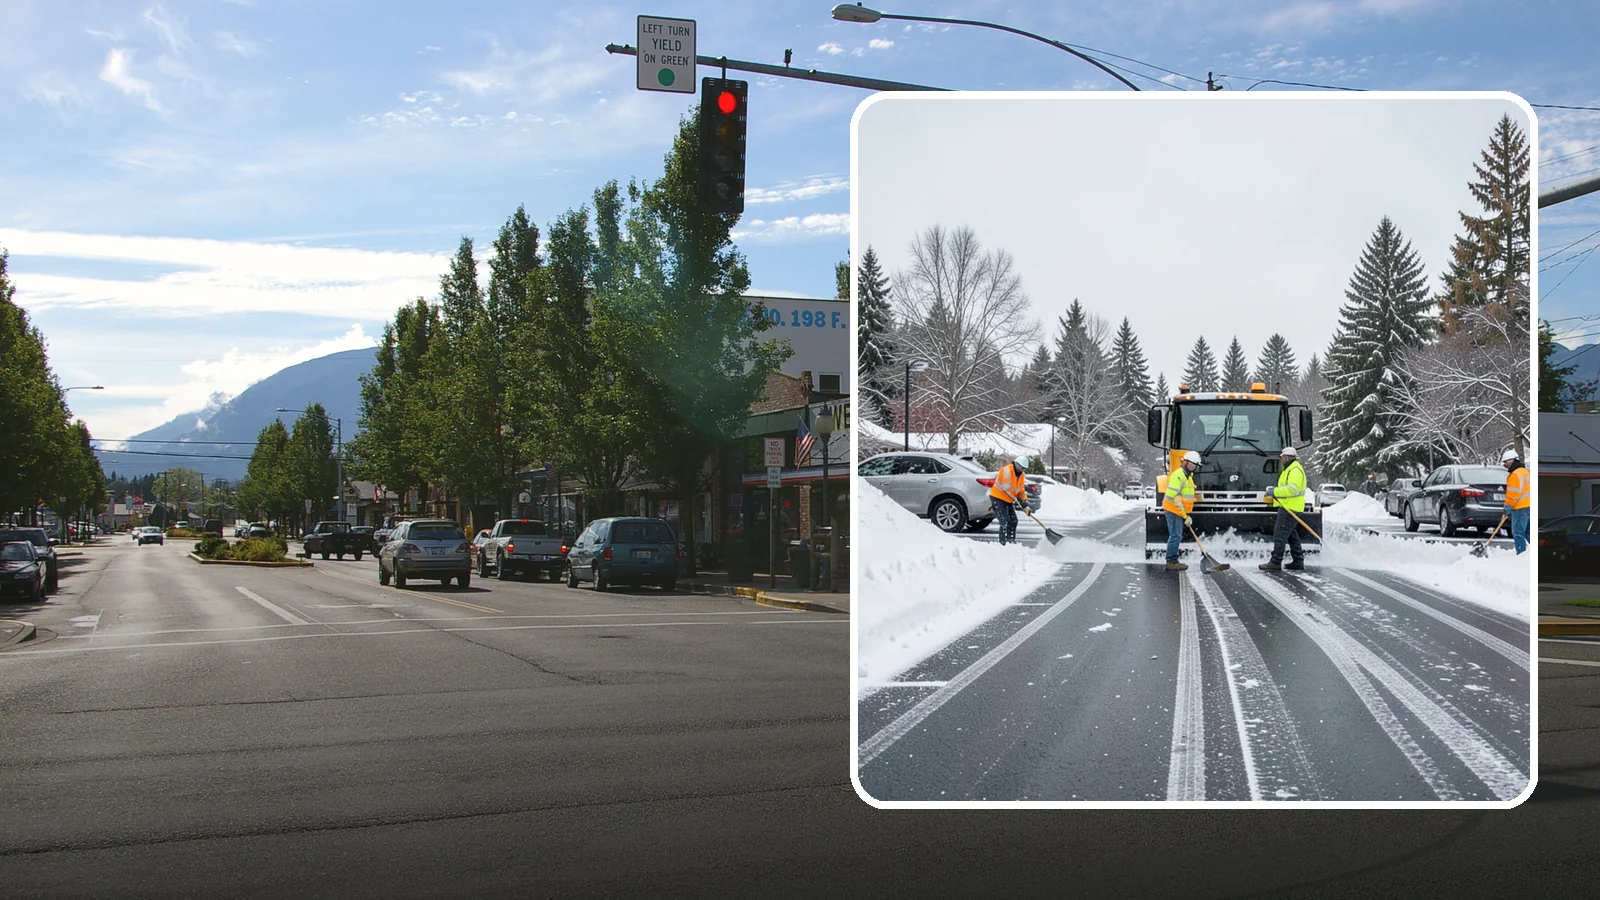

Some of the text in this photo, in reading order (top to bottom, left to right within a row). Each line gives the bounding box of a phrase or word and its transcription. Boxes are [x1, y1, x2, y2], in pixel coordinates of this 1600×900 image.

[643, 23, 690, 37] LEFT TURN
[652, 38, 682, 52] YIELD
[644, 53, 689, 66] ON GREEN
[791, 309, 826, 328] 198
[831, 311, 847, 329] F.
